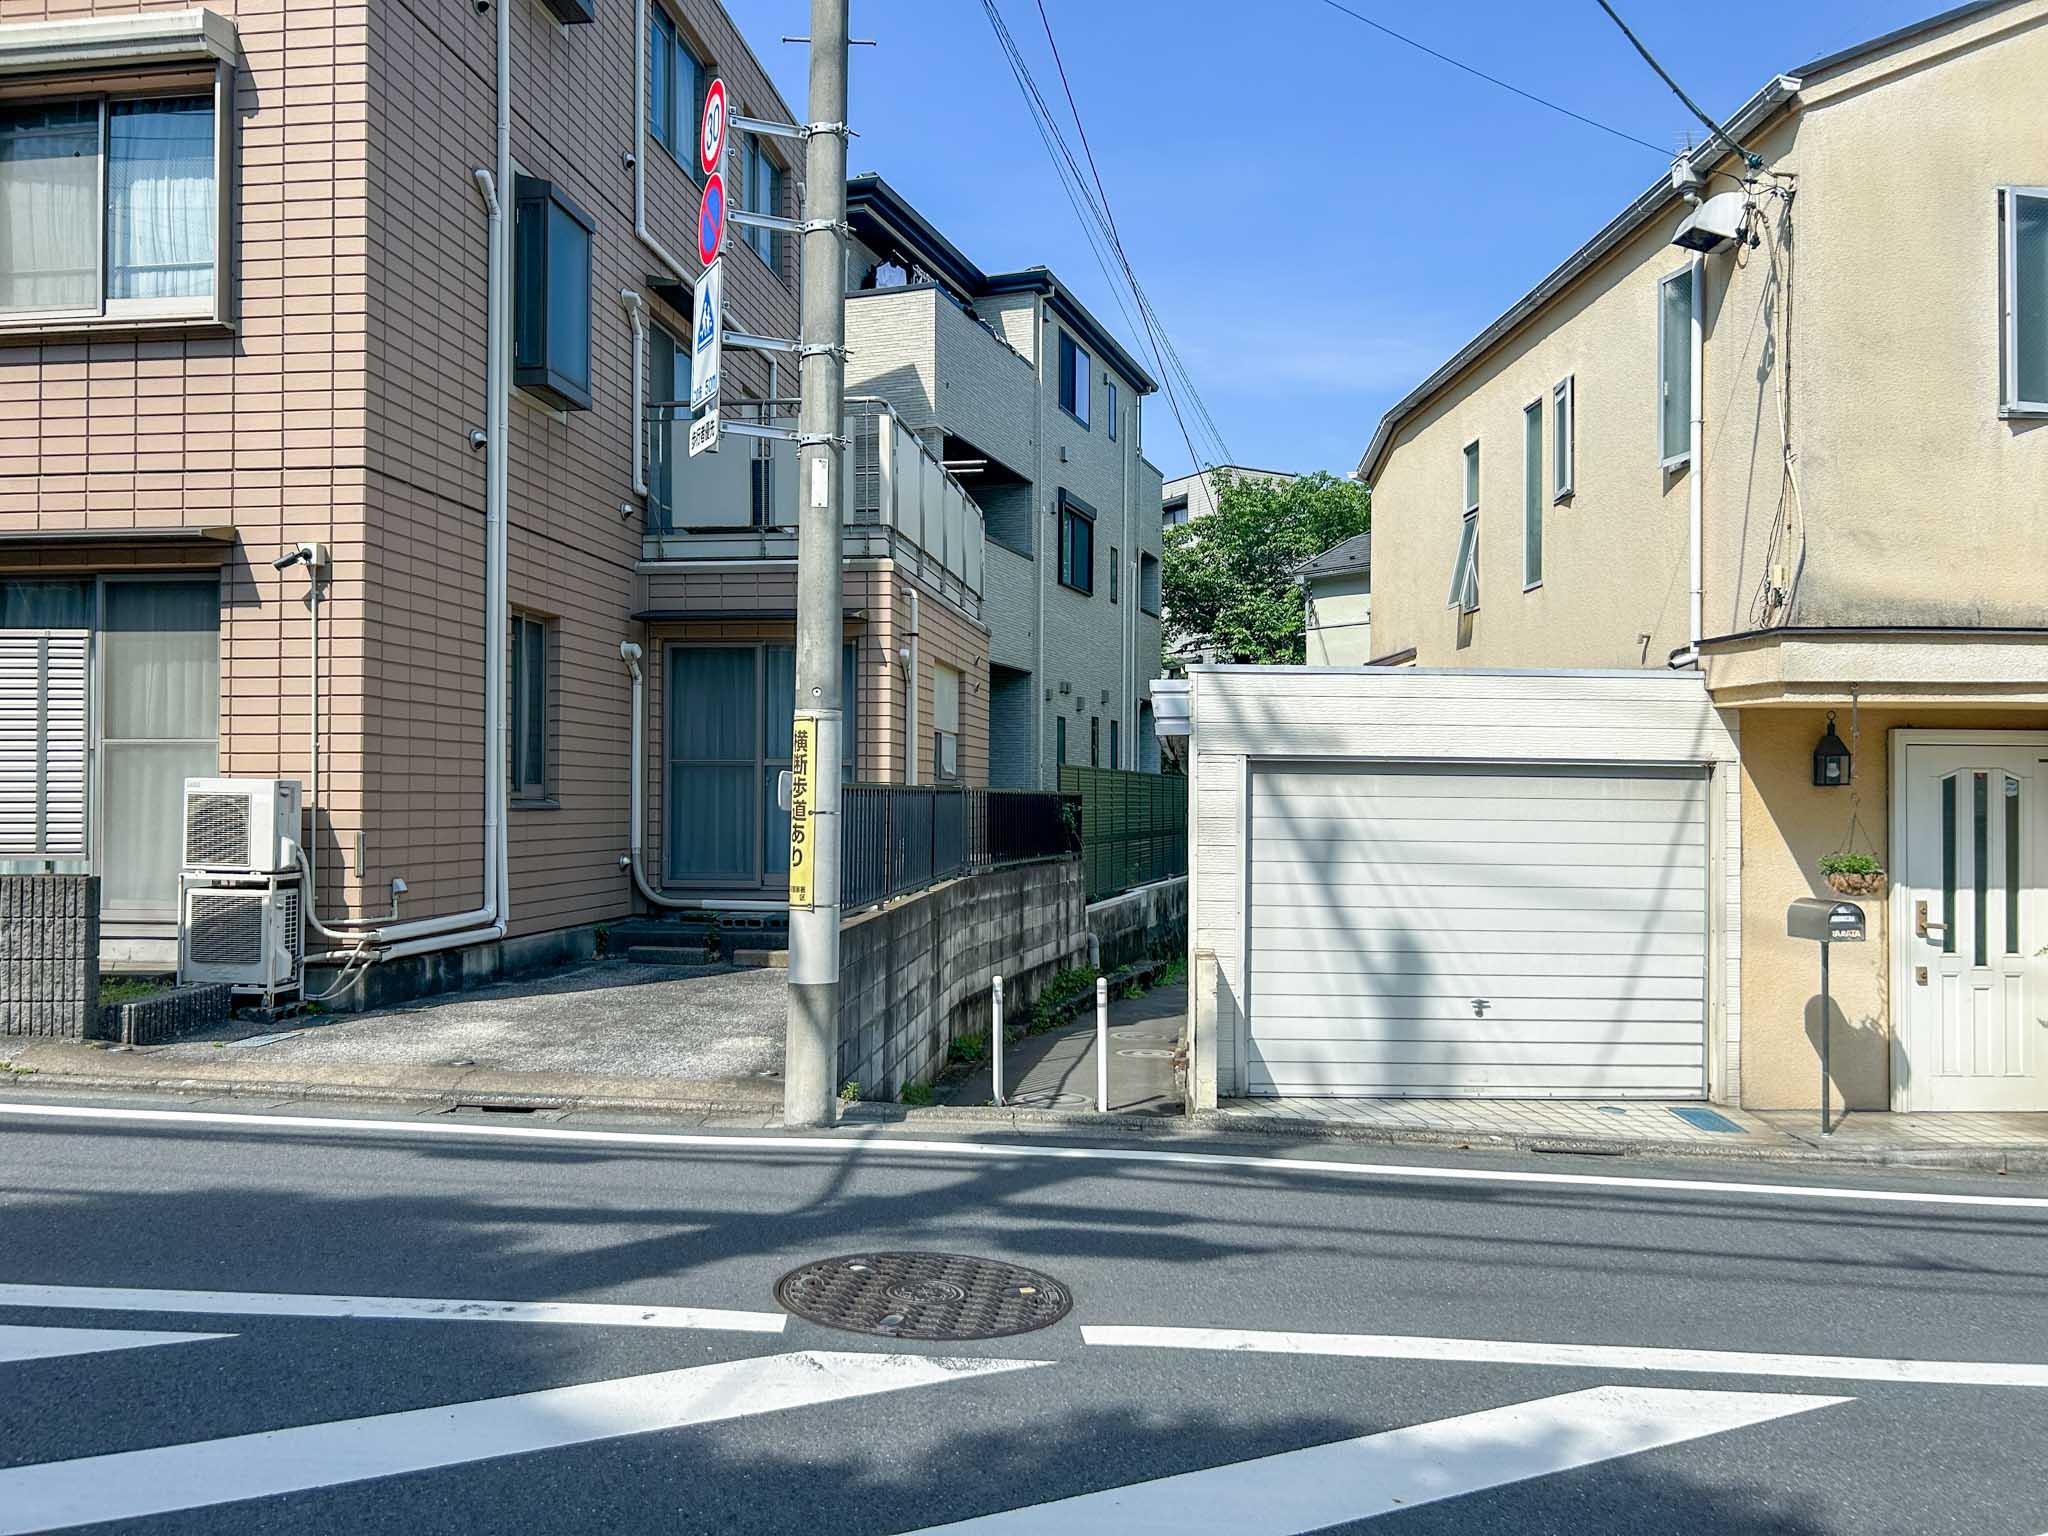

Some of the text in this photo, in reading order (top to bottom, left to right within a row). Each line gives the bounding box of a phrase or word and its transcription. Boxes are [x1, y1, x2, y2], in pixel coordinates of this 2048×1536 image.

[707, 103, 719, 151] 30
[792, 729, 808, 867] 横断歩道あり
